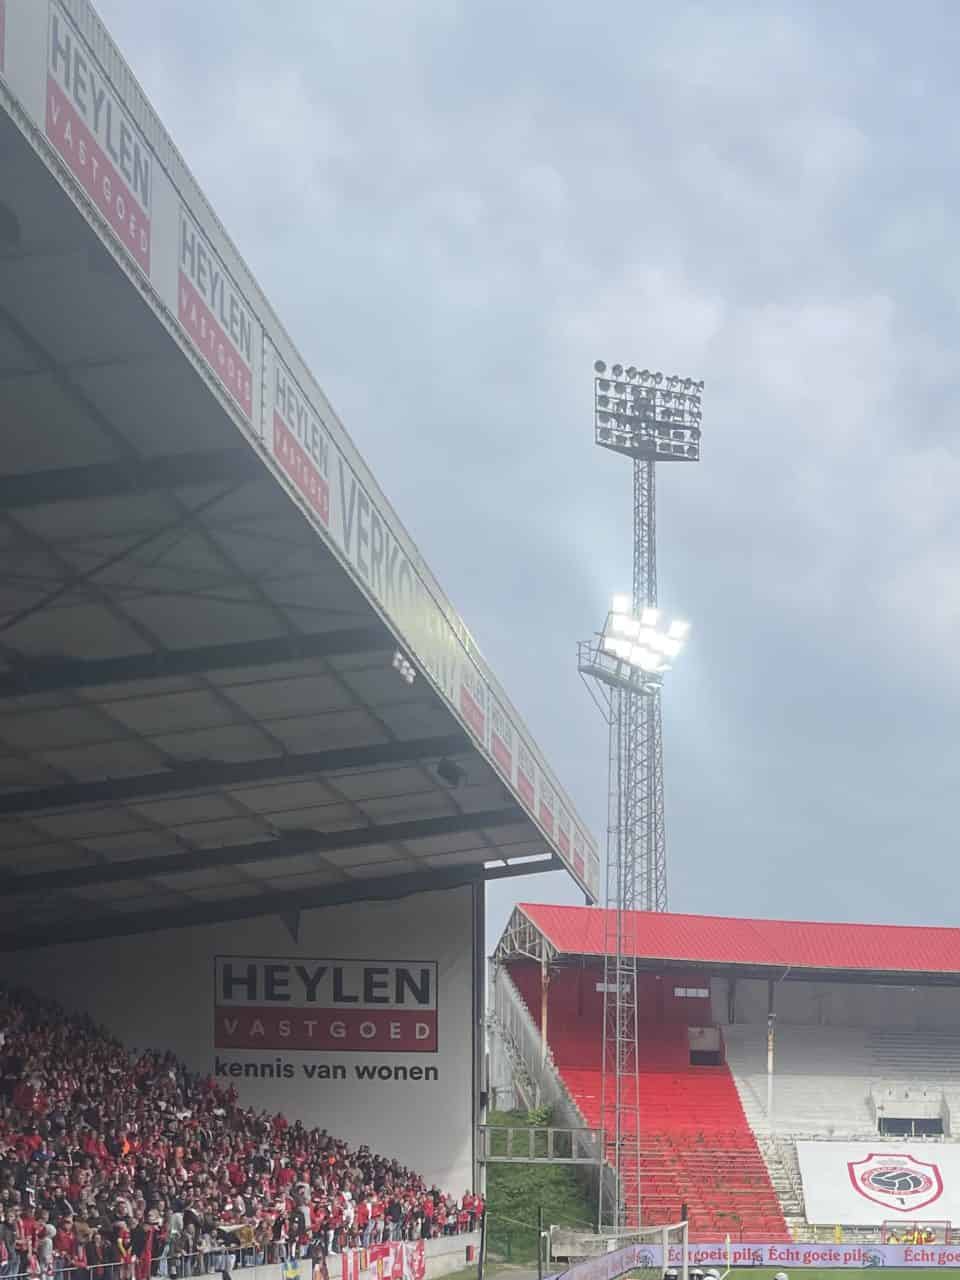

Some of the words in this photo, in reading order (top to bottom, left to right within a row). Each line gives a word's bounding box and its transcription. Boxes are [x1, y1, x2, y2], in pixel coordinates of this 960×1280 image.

[52, 14, 150, 209] HEYLEN
[51, 95, 149, 254] VASTGOED
[181, 219, 251, 361] HEYLEN
[221, 963, 431, 1005] HEYLEN
[223, 1017, 431, 1041] VASTGOED
[214, 1056, 295, 1080] kennis
[302, 1063, 347, 1080] van
[355, 1063, 439, 1081] wonen
[802, 1247, 840, 1264] goeie
